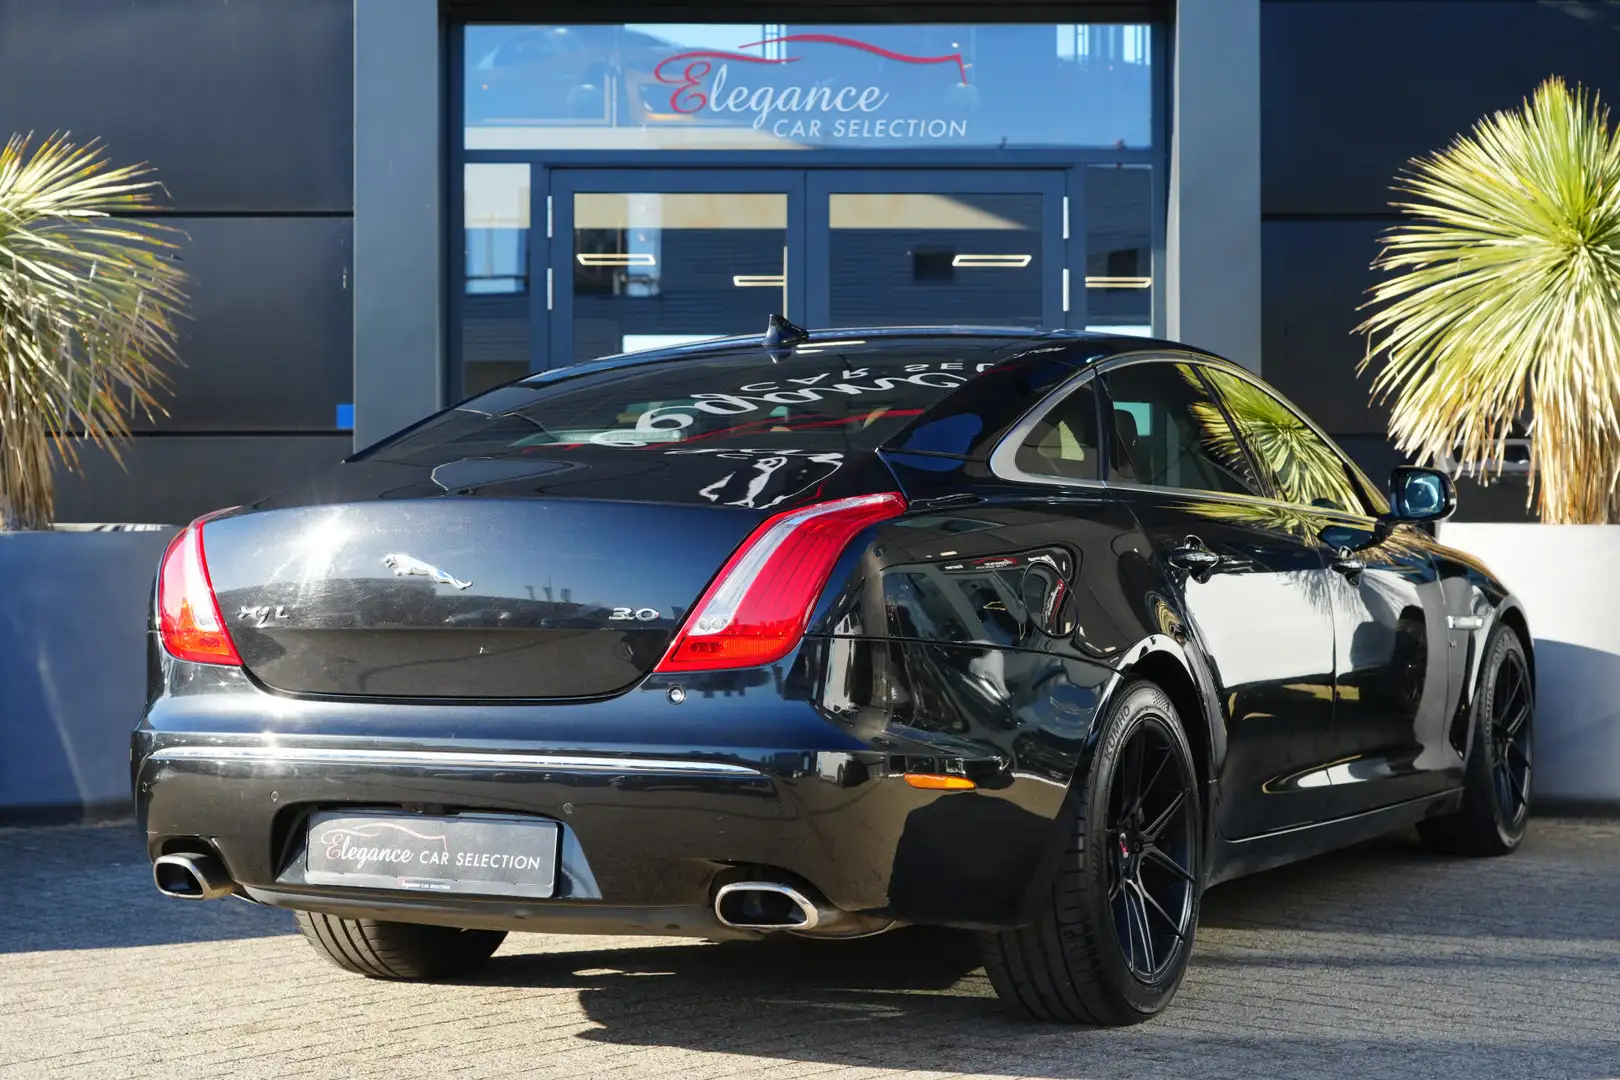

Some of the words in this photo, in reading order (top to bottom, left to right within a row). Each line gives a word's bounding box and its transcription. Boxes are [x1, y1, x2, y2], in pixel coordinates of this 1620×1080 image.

[655, 55, 889, 131] Elegance
[773, 119, 822, 138] CAR
[833, 118, 968, 138] SELECTION
[1104, 705, 1130, 760] KUMHO
[321, 829, 415, 868] Elegance
[419, 851, 449, 866] CAR
[456, 852, 541, 870] SELECTION
